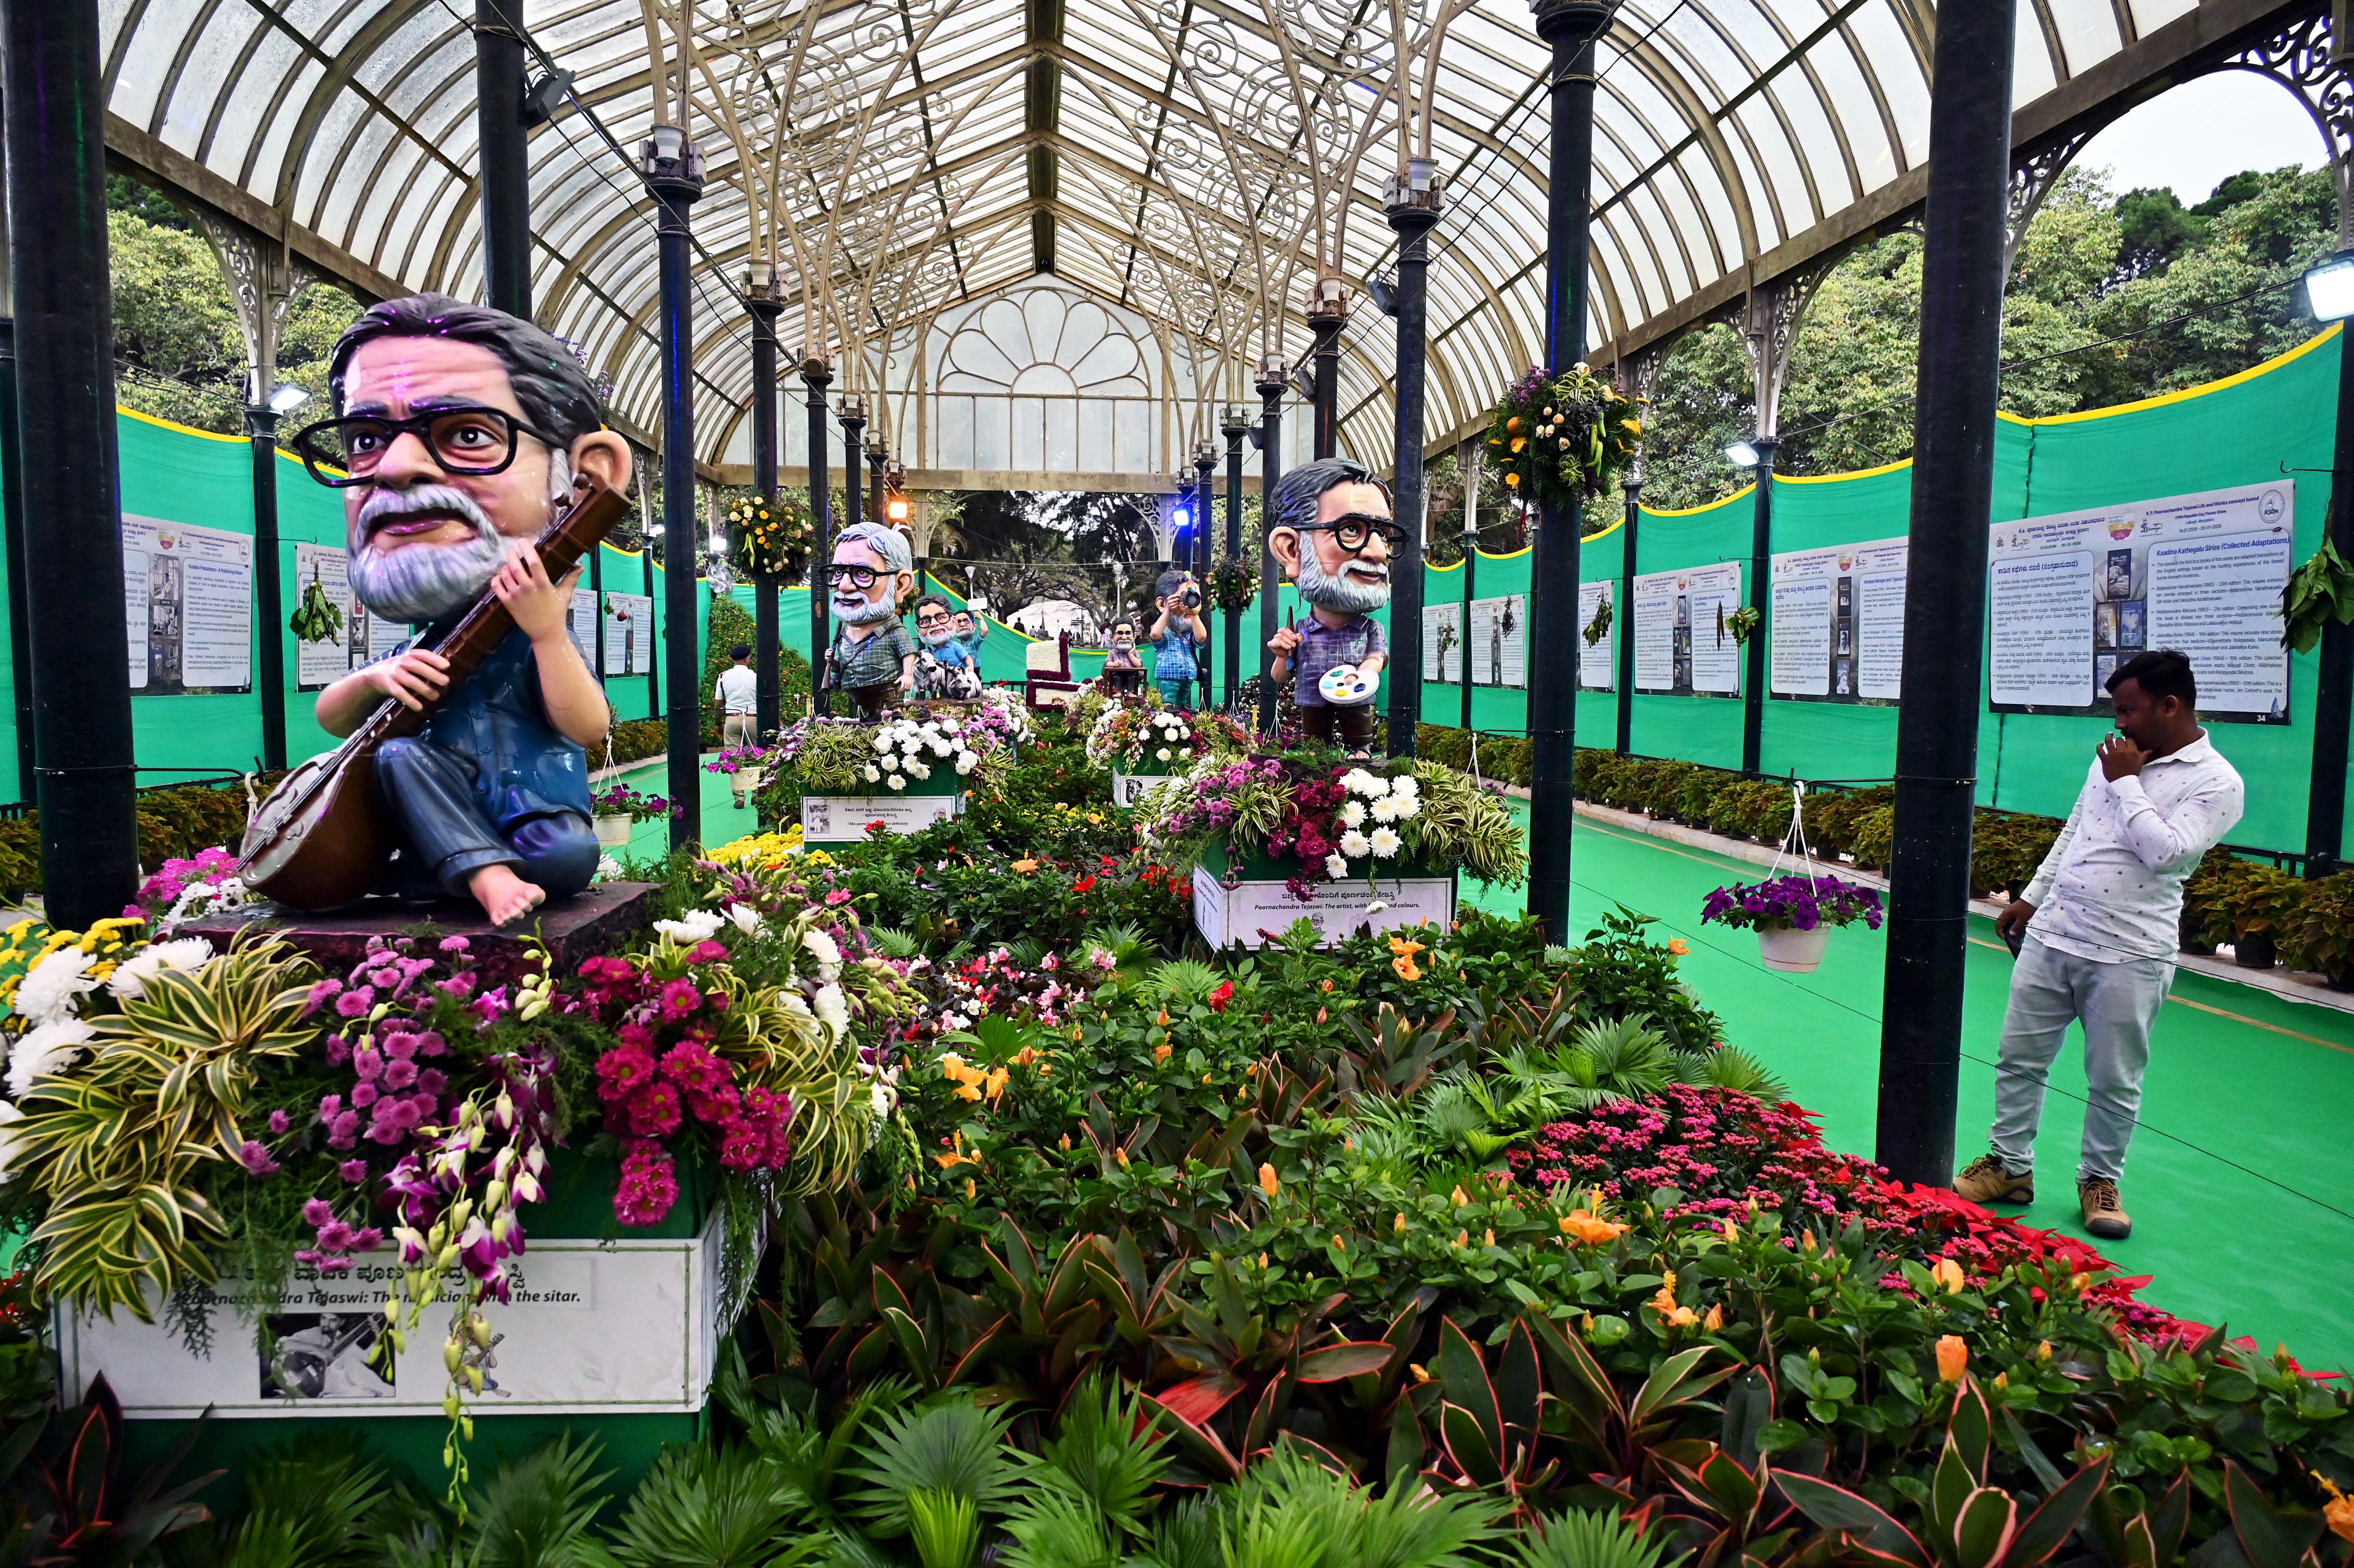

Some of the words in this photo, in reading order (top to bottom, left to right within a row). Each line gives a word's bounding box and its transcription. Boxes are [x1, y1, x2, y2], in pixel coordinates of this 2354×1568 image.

[2178, 545, 2203, 554] Kathegalu
[2221, 541, 2250, 550] (Collected
[2251, 536, 2289, 547] Adaptations)
[517, 1289, 540, 1302] the
[544, 1289, 580, 1303] sitar.
